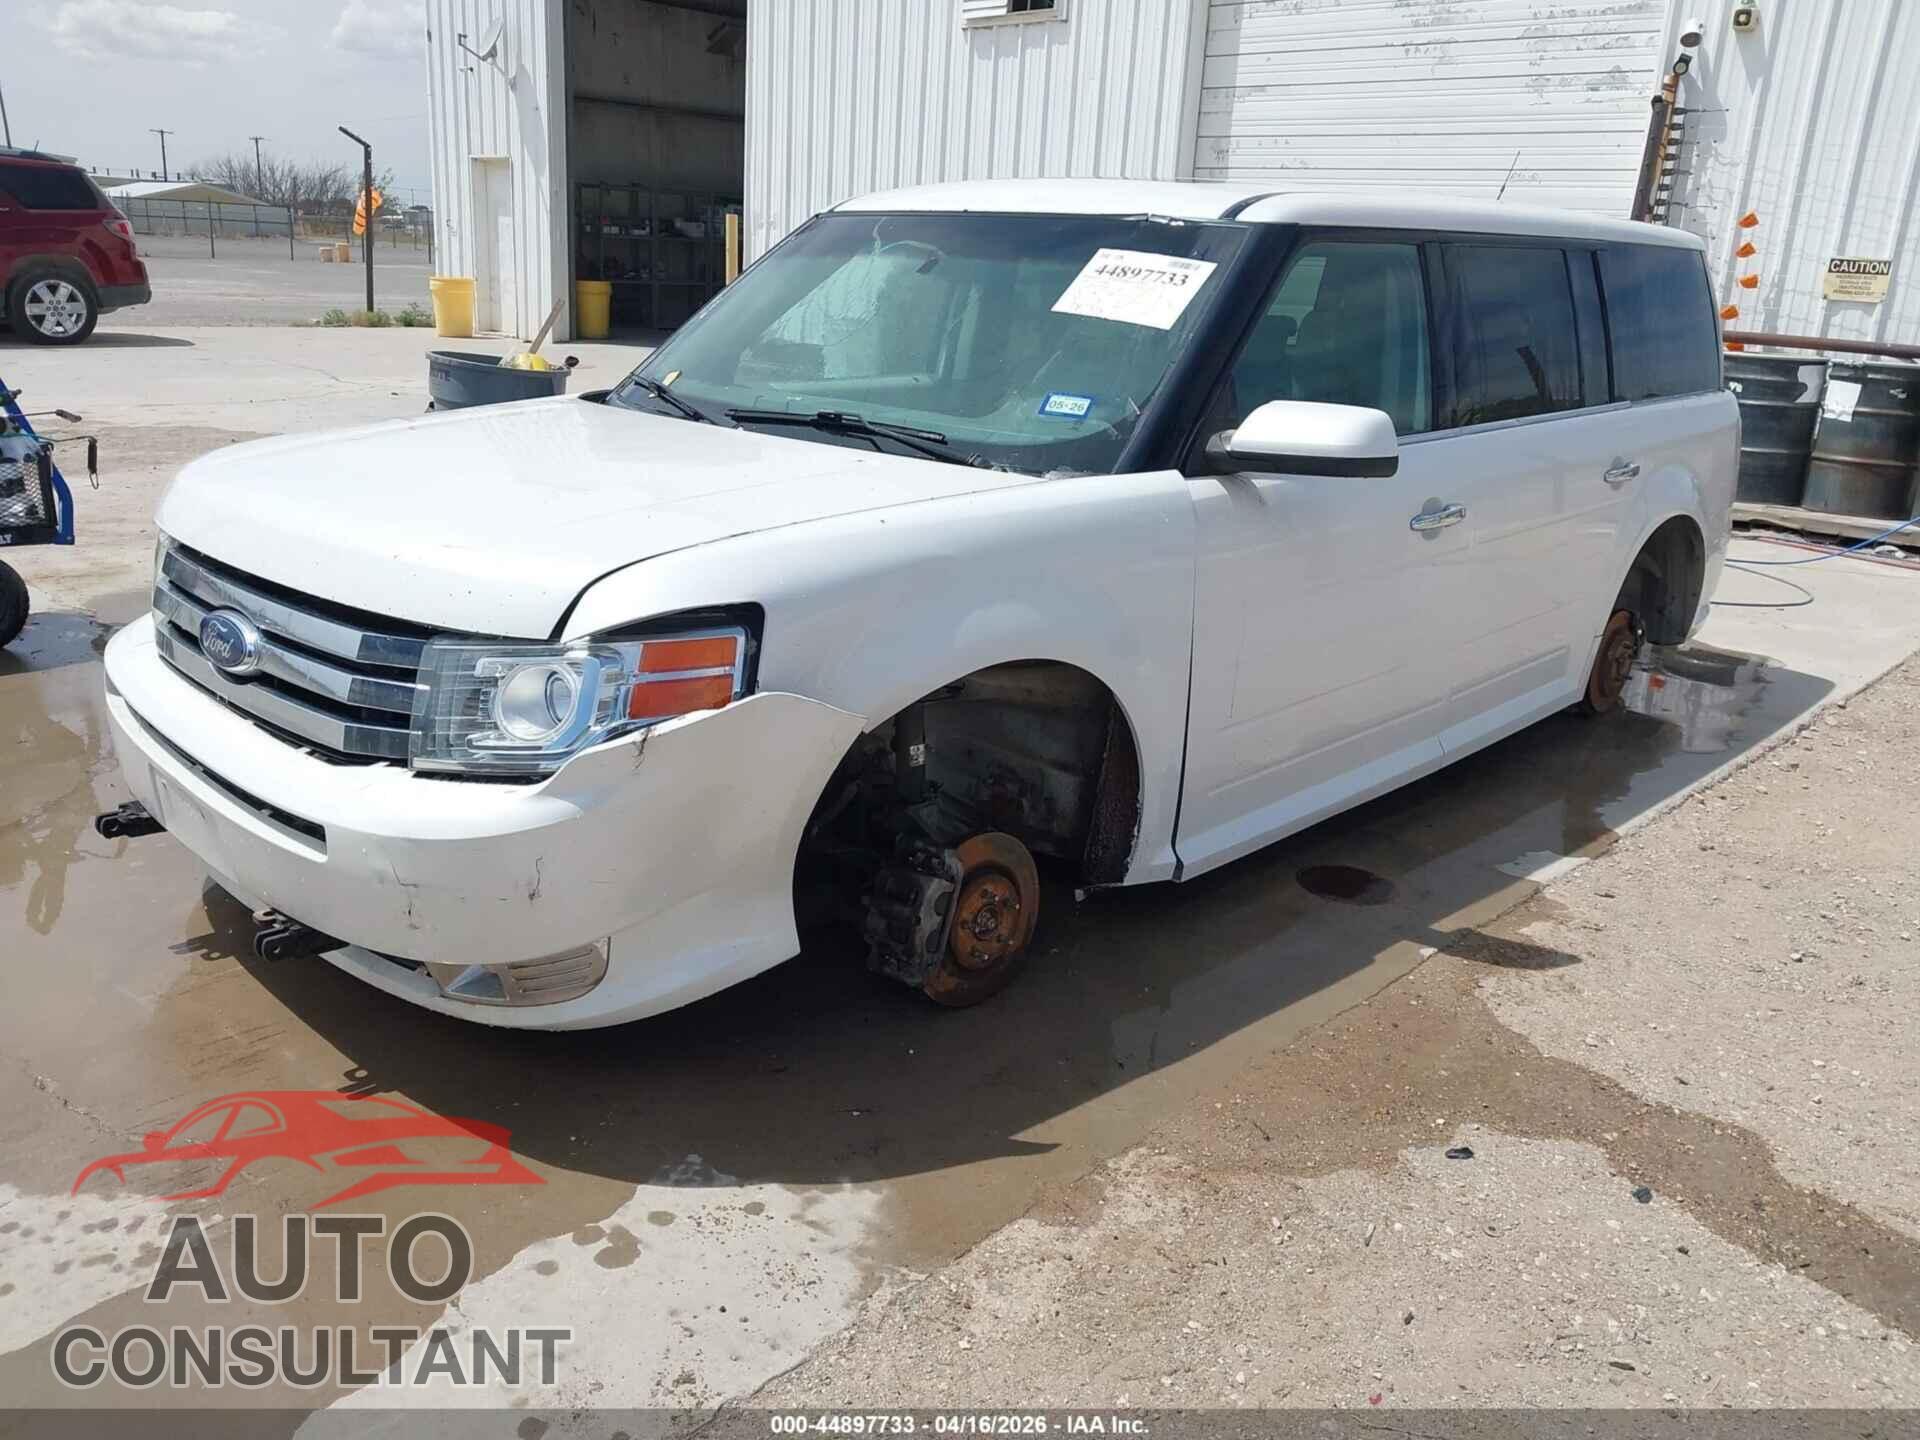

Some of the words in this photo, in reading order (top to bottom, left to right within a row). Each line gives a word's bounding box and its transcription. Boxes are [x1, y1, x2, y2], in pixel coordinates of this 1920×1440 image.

[1094, 263, 1190, 287] 44897733
[1830, 260, 1889, 274] CAUTION
[203, 620, 235, 658] Ford
